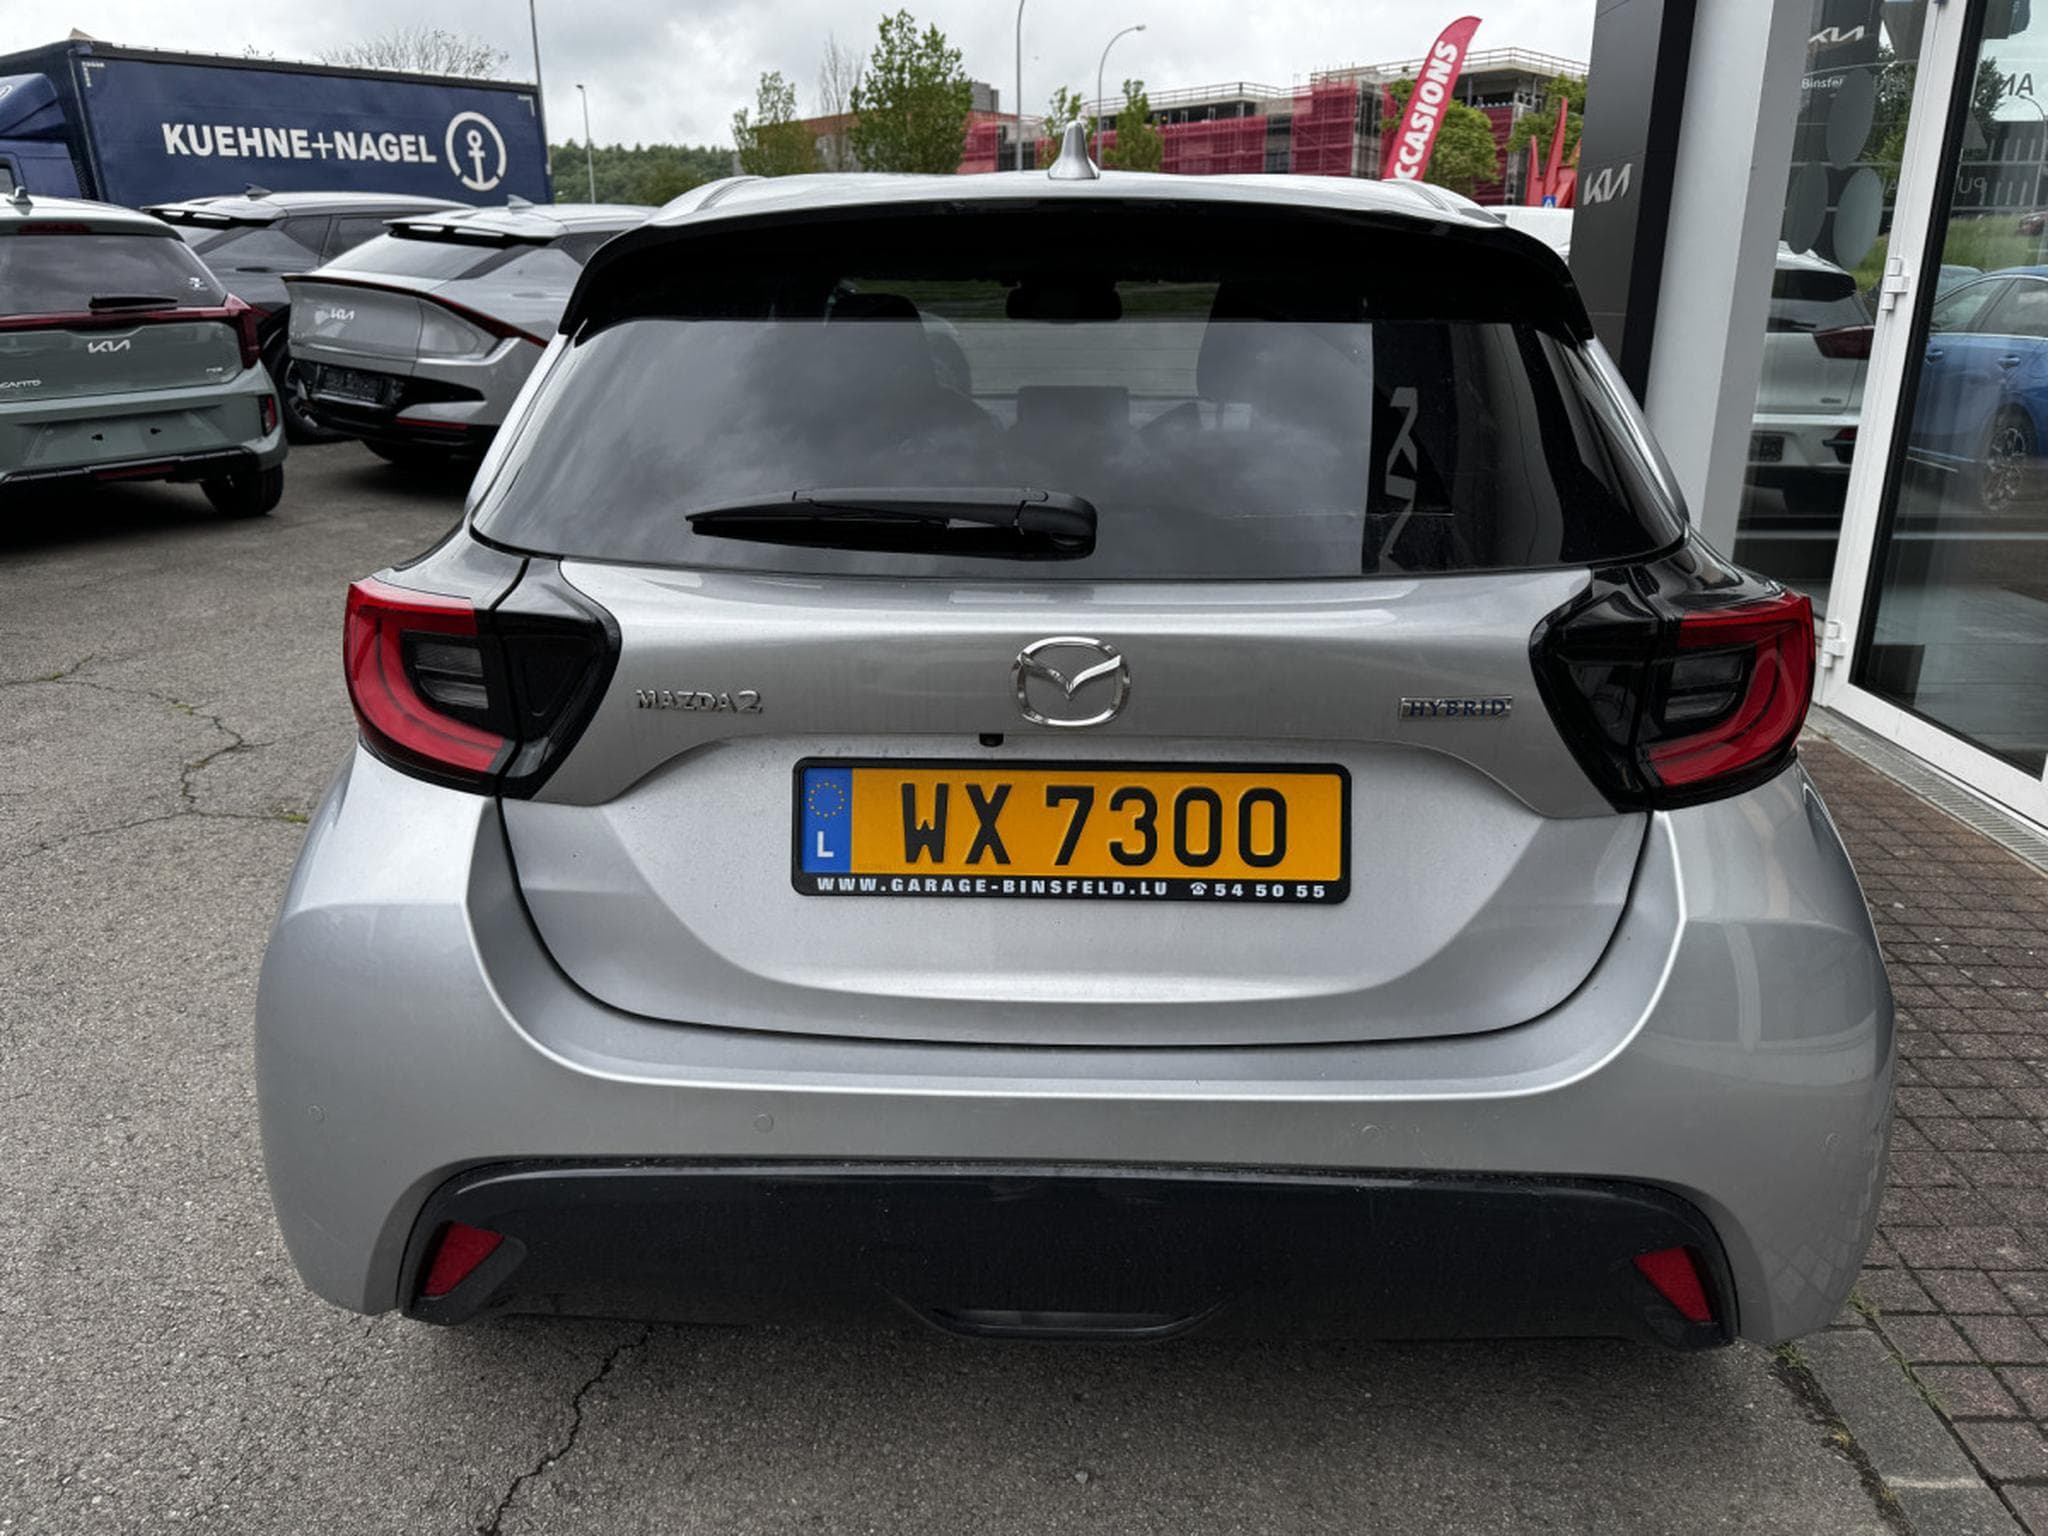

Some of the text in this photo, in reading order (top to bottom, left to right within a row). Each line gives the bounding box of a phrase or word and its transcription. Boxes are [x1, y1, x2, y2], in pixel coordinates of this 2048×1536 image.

[1801, 75, 1844, 89] Binsfel
[1394, 40, 1459, 180] CCASIONS
[161, 123, 437, 163] KUEHNE+NAGEL
[1583, 163, 1632, 205] KIA
[88, 339, 131, 353] KIA
[1408, 699, 1507, 718] HYBRID
[901, 782, 1287, 868] WX 7300
[816, 830, 834, 858] L
[816, 877, 1326, 898] WWW.GARAGE-BINSFELD.LU 54 50 55
